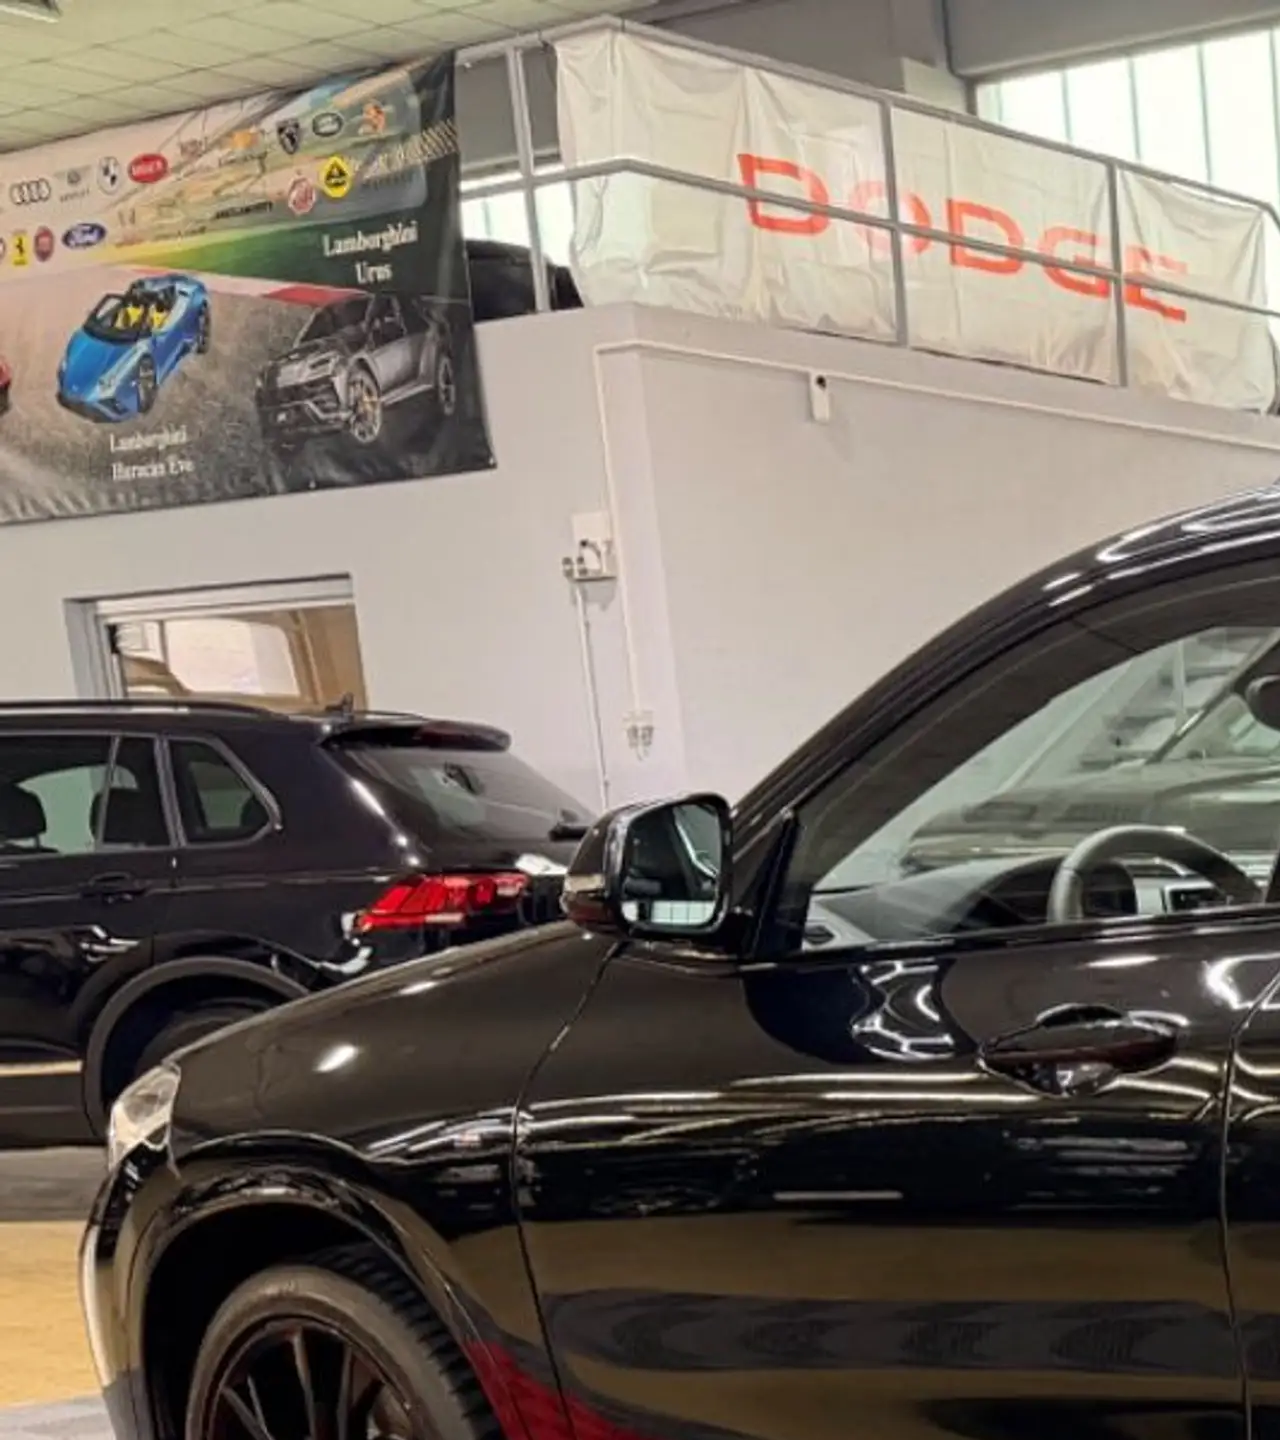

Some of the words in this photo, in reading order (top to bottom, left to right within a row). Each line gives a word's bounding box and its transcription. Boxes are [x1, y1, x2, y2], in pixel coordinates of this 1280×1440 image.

[322, 220, 418, 257] Lamborghini
[736, 153, 1188, 323] DODGE
[355, 261, 393, 285] Urus
[109, 423, 188, 453] Lamborghini
